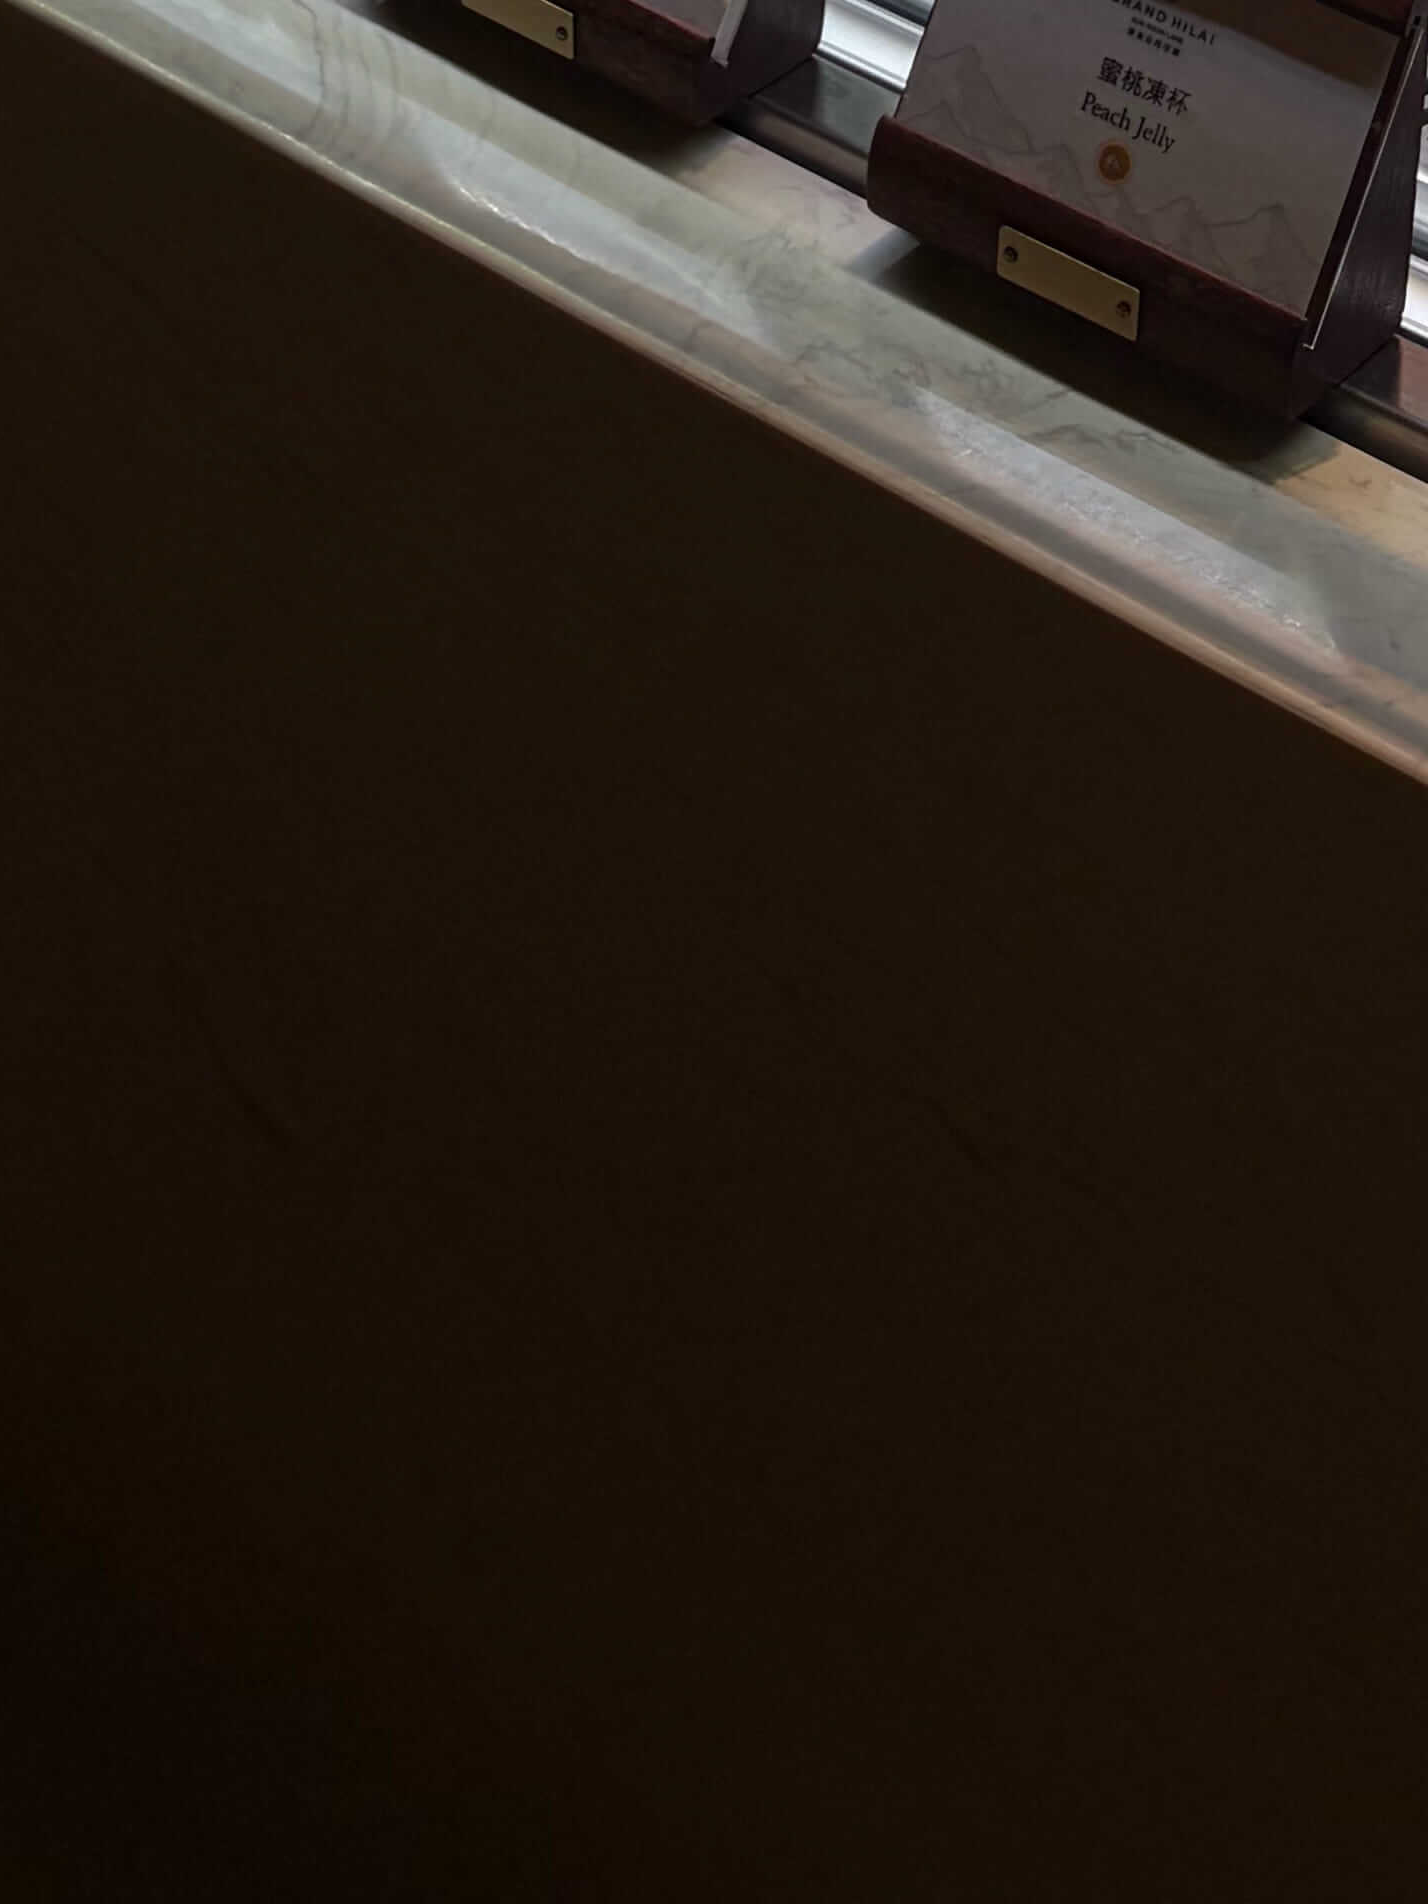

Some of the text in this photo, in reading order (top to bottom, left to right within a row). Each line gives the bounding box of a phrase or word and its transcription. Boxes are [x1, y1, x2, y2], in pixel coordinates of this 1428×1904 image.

[1171, 16, 1216, 46] HILAI
[1081, 91, 1176, 154] Peach Jelly
